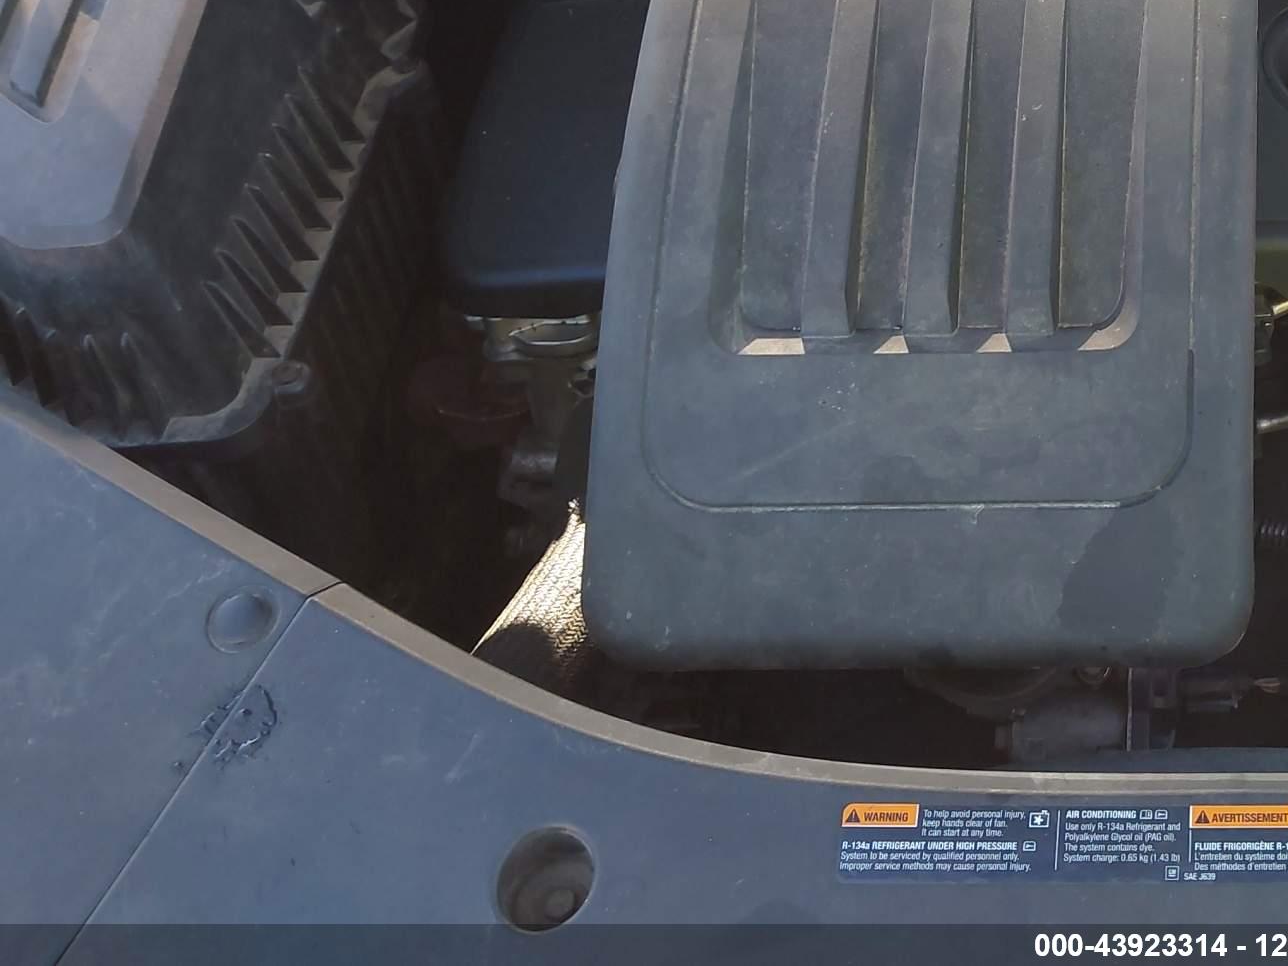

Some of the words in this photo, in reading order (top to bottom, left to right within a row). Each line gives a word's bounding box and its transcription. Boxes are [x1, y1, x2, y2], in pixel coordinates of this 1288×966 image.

[864, 812, 908, 822] WARNING
[924, 809, 931, 818] To
[933, 810, 949, 820] help
[951, 810, 970, 818] avoid
[972, 810, 1002, 820] personal
[1066, 810, 1079, 819] AIR
[1082, 810, 1136, 819] CONDITIONING
[1211, 813, 1288, 822] AVERTISSEMENT
[922, 819, 940, 829] keep
[942, 819, 963, 827] hands
[966, 819, 982, 827] clear
[985, 819, 993, 827] of
[994, 819, 1008, 827] fan.
[1081, 823, 1096, 832] only
[1126, 823, 1165, 832] Refrigerant
[971, 829, 984, 838] any
[1065, 833, 1108, 842] Polyalkylene
[1111, 833, 1132, 842] Glycol
[1134, 833, 1142, 841] oil
[1145, 833, 1161, 841] (PAG
[1163, 833, 1176, 841] oil).
[842, 841, 870, 850] R-134a
[872, 841, 925, 850] REFRIGERANT
[927, 841, 954, 850] UNDER
[956, 841, 974, 850] HIGH
[977, 841, 1017, 850] PRESSURE
[1064, 843, 1077, 851] The
[1079, 843, 1105, 853] system
[1107, 843, 1137, 851] contains
[1139, 843, 1155, 853] dye.
[1195, 842, 1222, 850] FLUIDE
[1224, 841, 1274, 850] FRIGORIGÈNE
[840, 851, 867, 861] System
[870, 851, 877, 859] to
[879, 851, 887, 859] be
[890, 851, 920, 859] serviced
[922, 851, 931, 861] by
[933, 851, 964, 861] qualified
[966, 851, 1001, 861] personnel
[1003, 851, 1019, 861] only.
[1063, 853, 1090, 863] System
[1092, 853, 1119, 863] charge:
[1121, 853, 1137, 861] 0.65
[1139, 853, 1148, 863] kg
[1150, 853, 1169, 862] (1.43
[1171, 853, 1180, 862] lb)
[1194, 852, 1232, 860] L'entretien
[1234, 852, 1242, 860] du
[1245, 852, 1275, 862] système
[840, 862, 872, 871] Improper
[874, 862, 900, 870] service
[902, 862, 933, 870] methods
[935, 862, 951, 871] may
[977, 862, 1007, 871] personal
[1010, 862, 1031, 871] injury.
[1194, 862, 1208, 870] Des
[1210, 862, 1245, 870] méthodes
[1247, 862, 1286, 870] d'entretien
